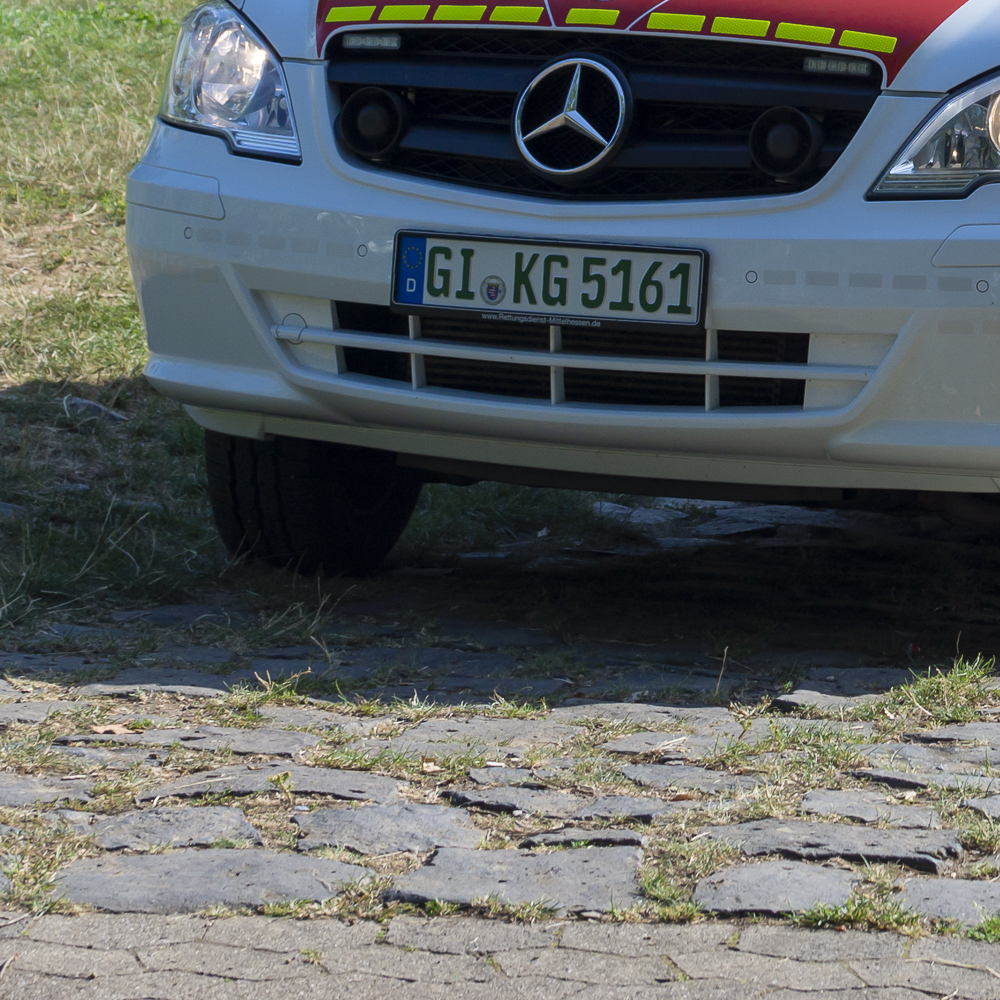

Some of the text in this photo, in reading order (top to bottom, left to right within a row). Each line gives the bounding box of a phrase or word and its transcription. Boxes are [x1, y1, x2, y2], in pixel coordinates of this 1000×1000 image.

[406, 278, 416, 293] D
[426, 246, 693, 315] GI KG 5161
[481, 312, 601, 328] www.Rettungsdienst-Mittelhessen.de
